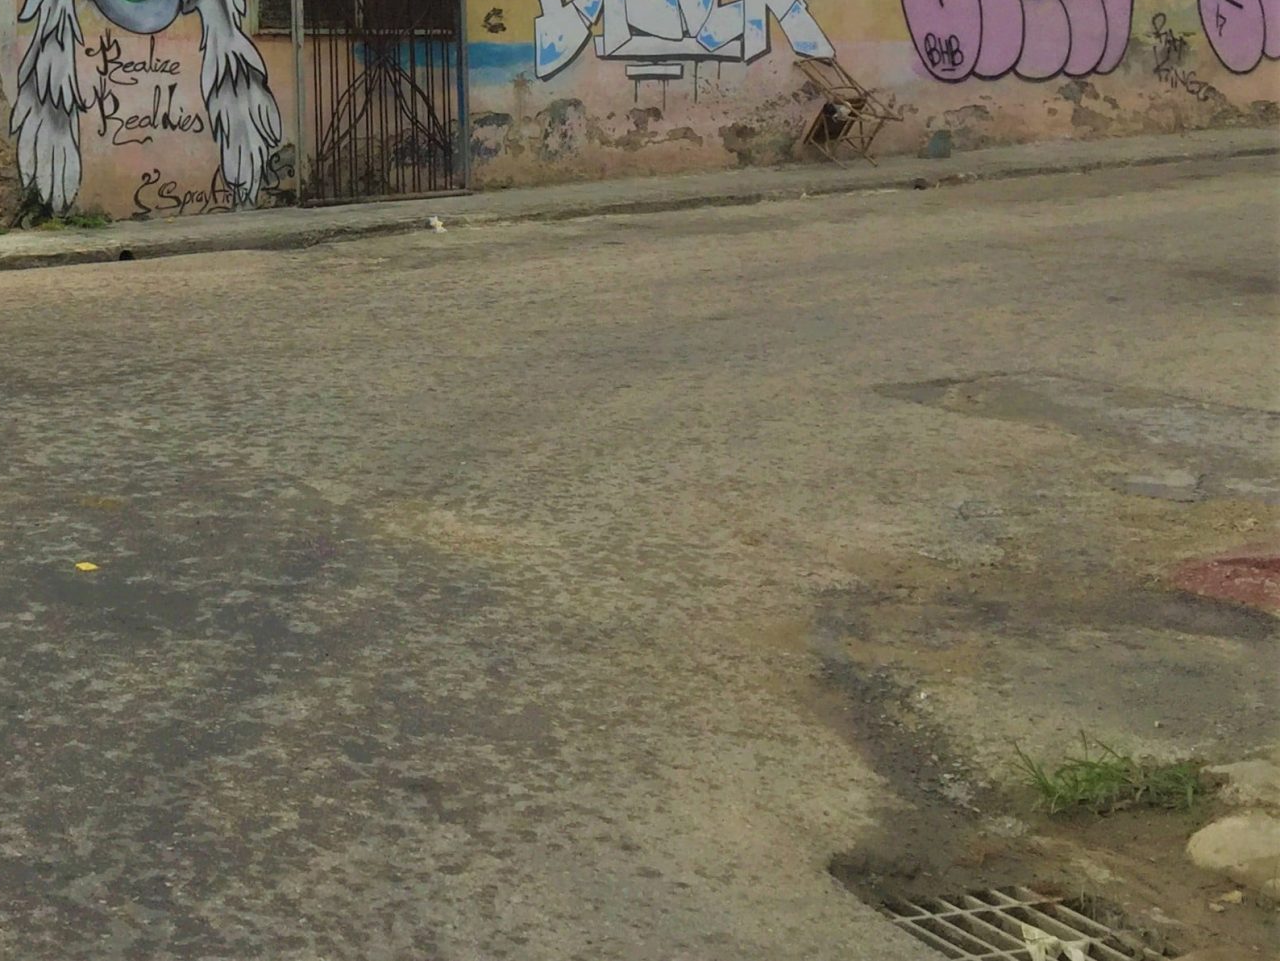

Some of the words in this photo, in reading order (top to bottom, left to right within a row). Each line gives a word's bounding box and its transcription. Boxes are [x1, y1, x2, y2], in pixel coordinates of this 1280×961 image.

[86, 28, 181, 85] Realize
[83, 77, 159, 145] Real
[162, 83, 204, 132] Lies
